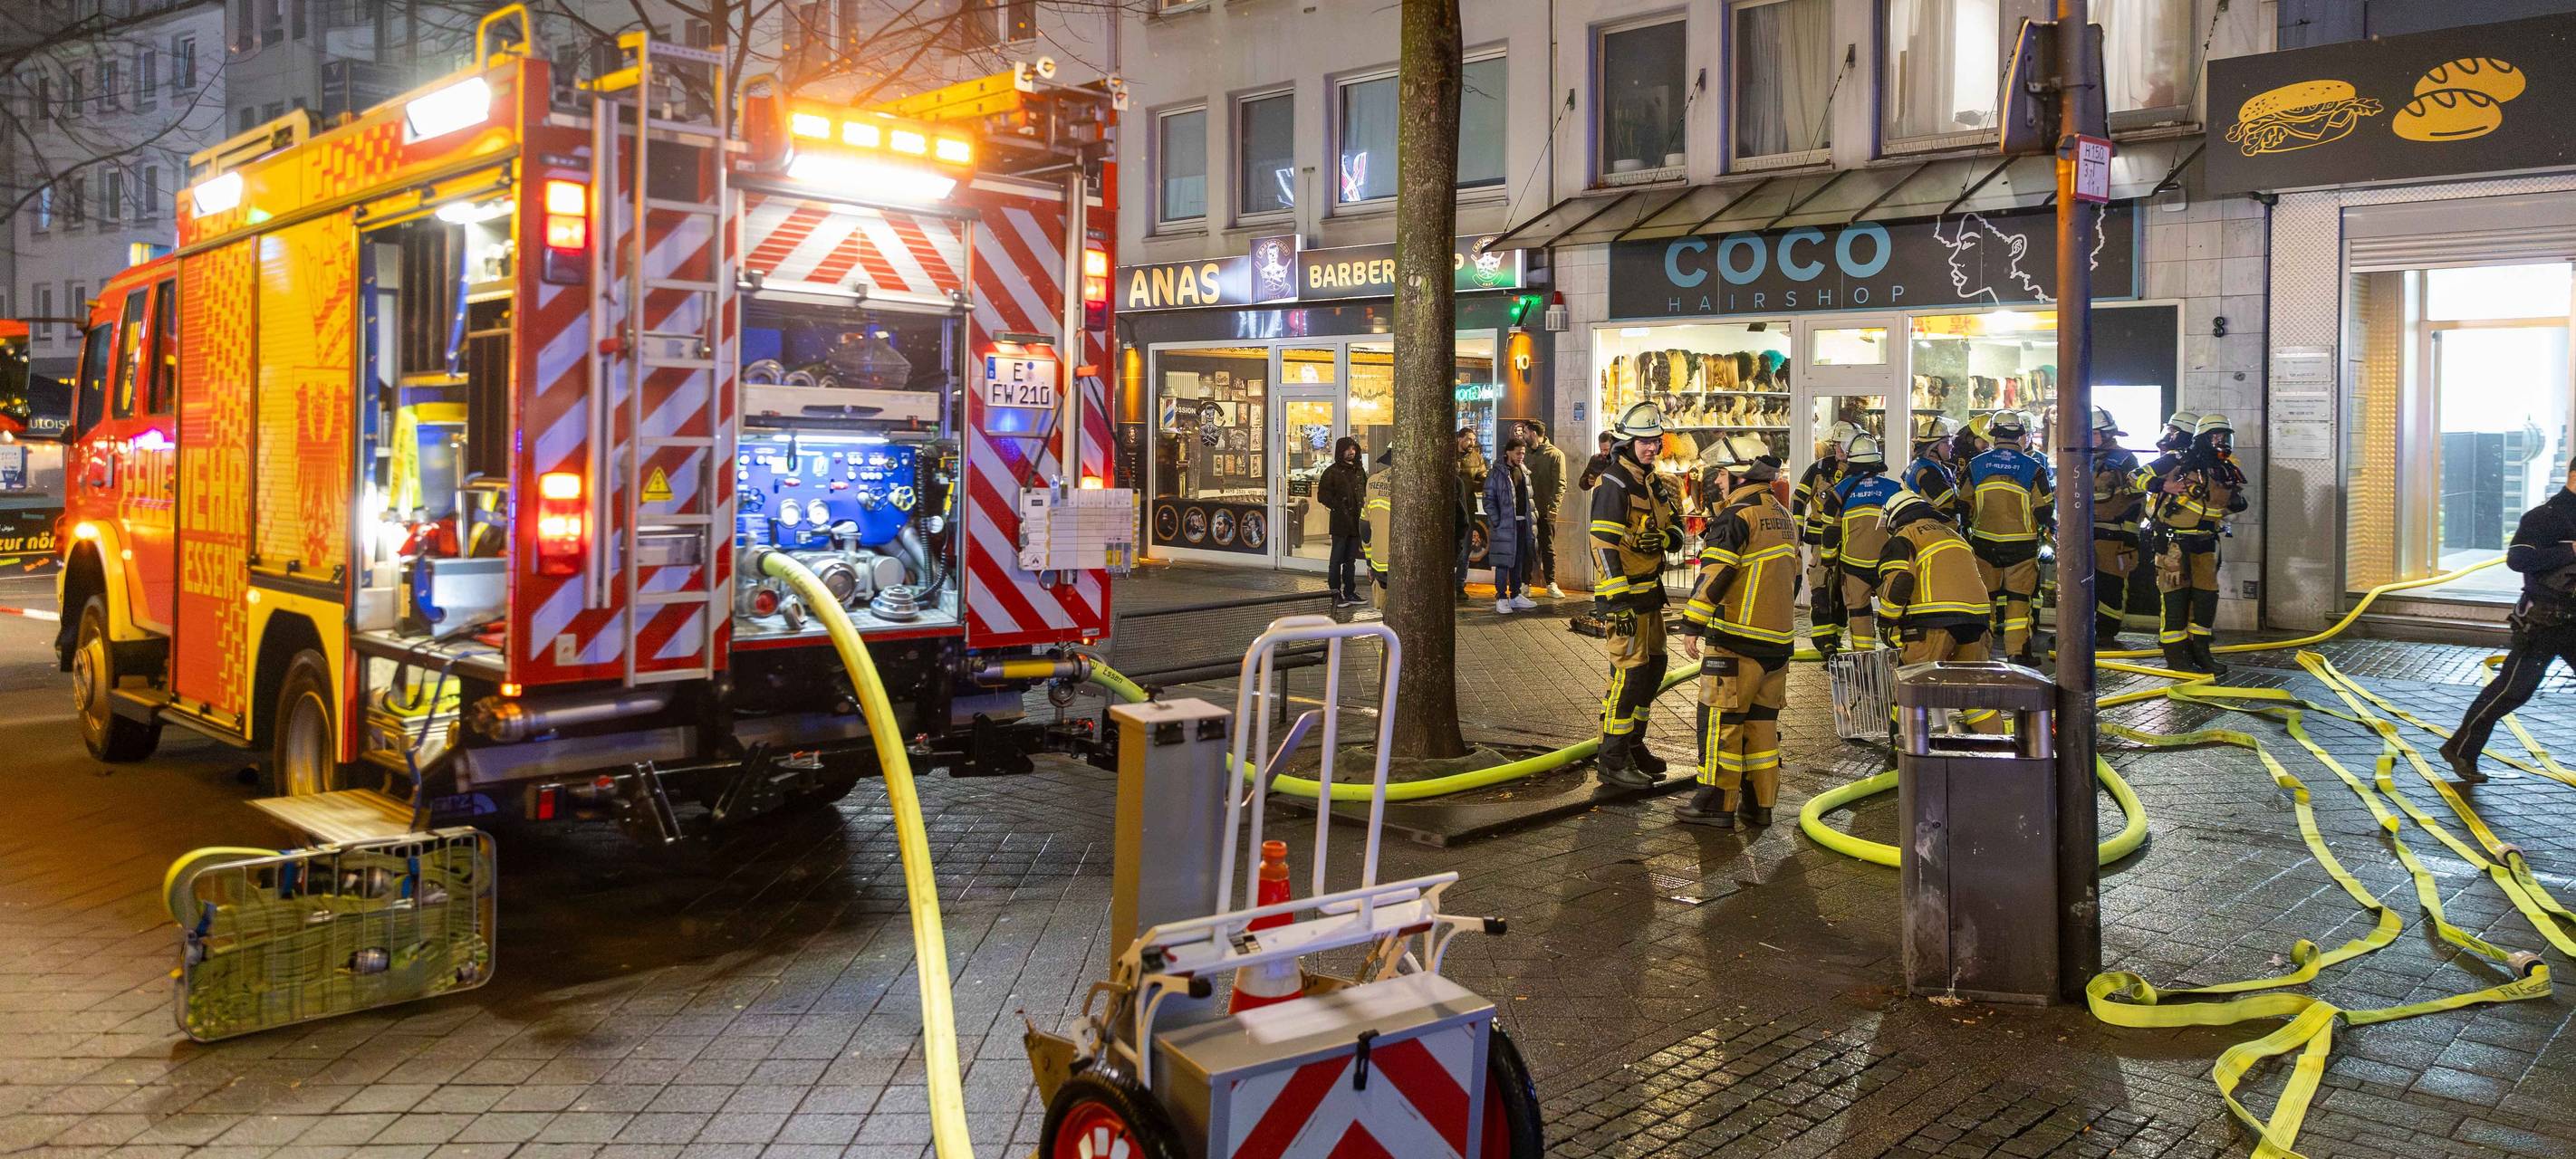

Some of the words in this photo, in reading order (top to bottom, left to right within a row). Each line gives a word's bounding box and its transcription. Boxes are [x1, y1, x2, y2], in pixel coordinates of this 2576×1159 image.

[1665, 220, 1892, 288] COCO
[1129, 263, 1220, 308] ANAS
[1668, 285, 1905, 312] HAIRSHOP
[2213, 316, 2225, 338] 8
[1515, 351, 1530, 369] 10
[1014, 362, 1023, 381] E
[993, 384, 1014, 403] FW
[1019, 385, 1050, 405] 210
